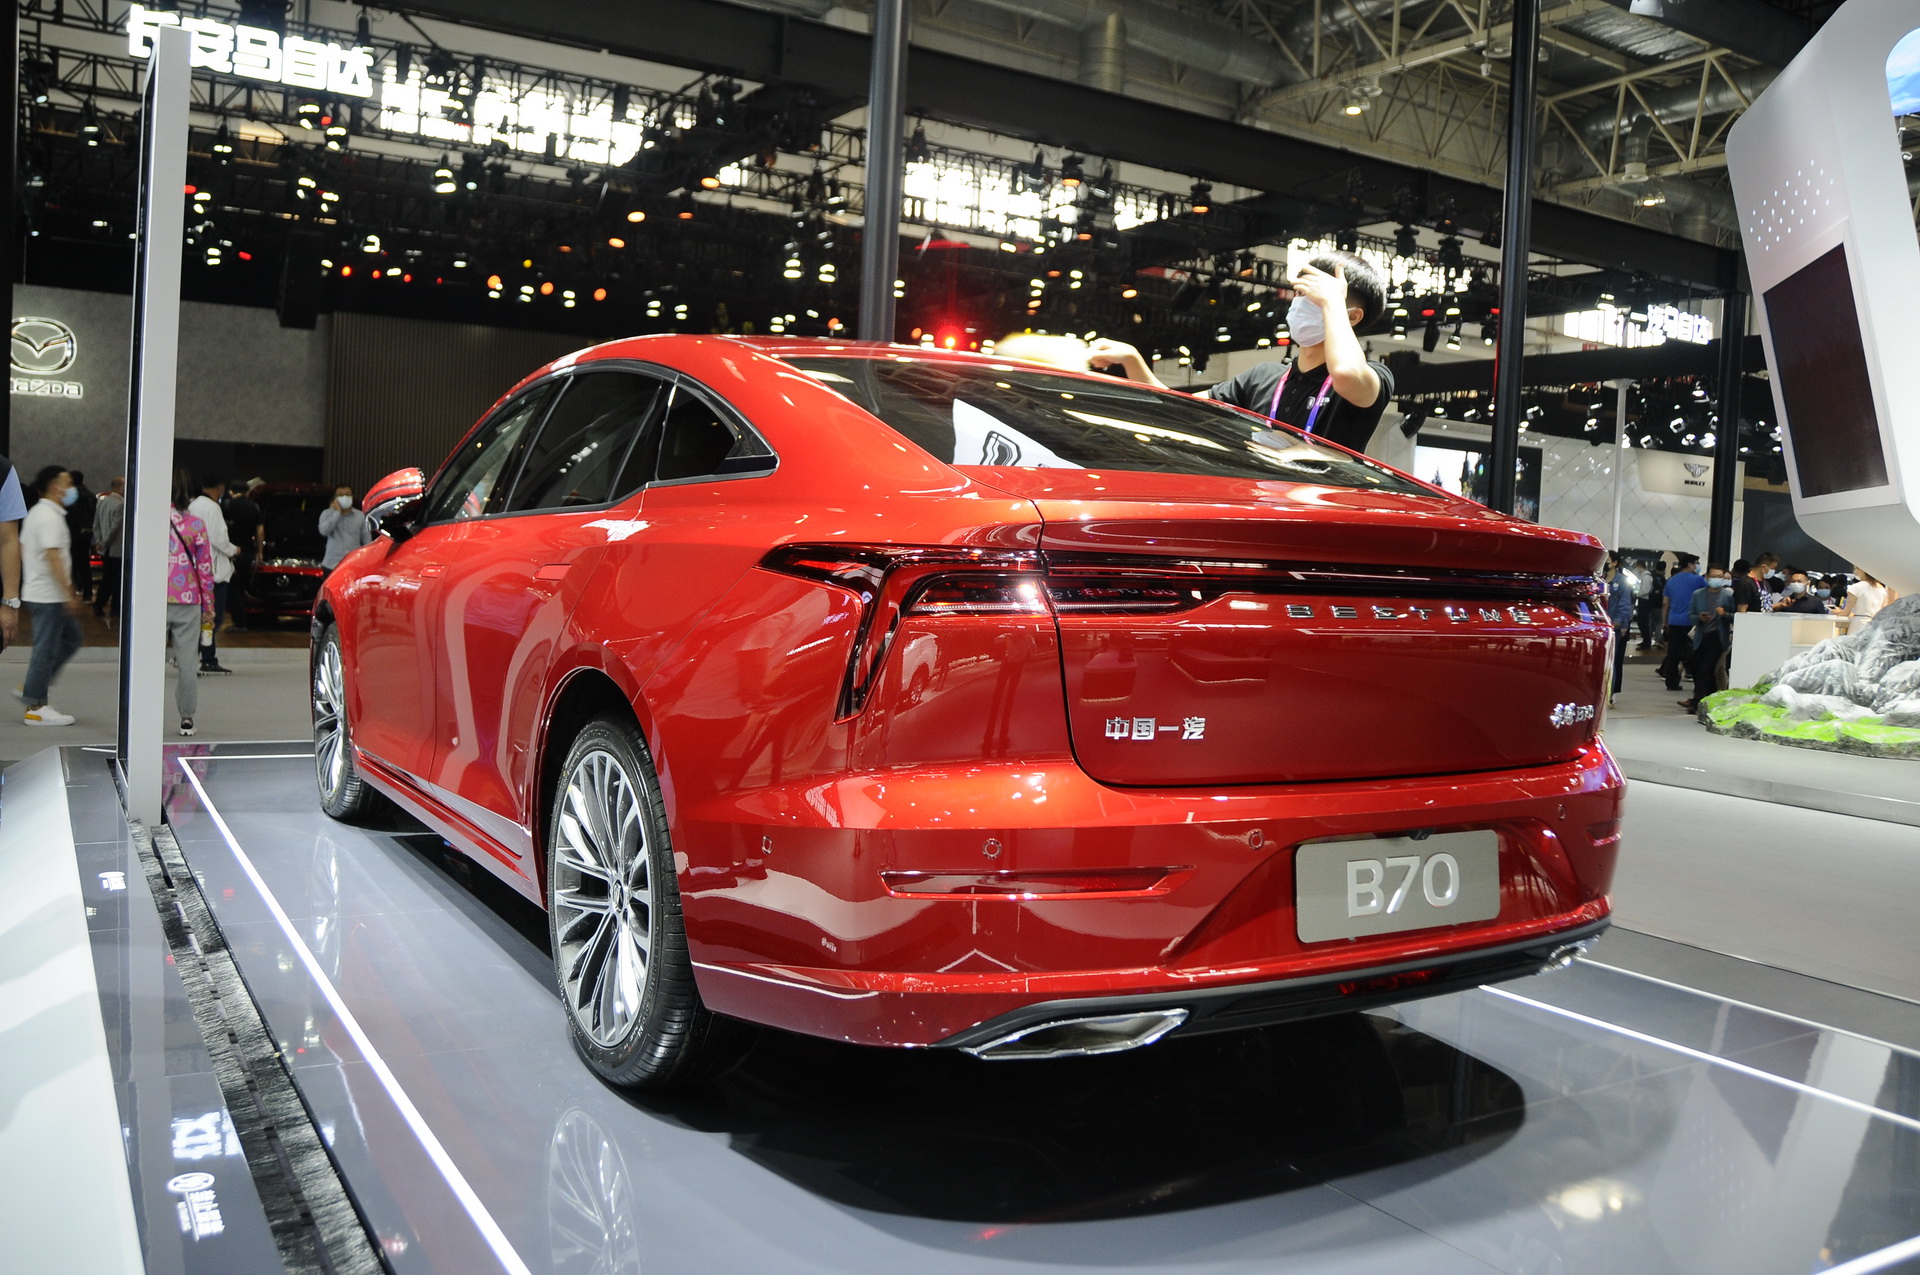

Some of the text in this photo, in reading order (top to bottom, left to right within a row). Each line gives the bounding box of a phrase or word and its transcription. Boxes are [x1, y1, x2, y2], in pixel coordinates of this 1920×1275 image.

[126, 4, 375, 98] 长安马自达
[1285, 604, 1532, 623] BESTUNE
[1105, 716, 1206, 740] 中国一汽
[1346, 852, 1460, 918] B70
